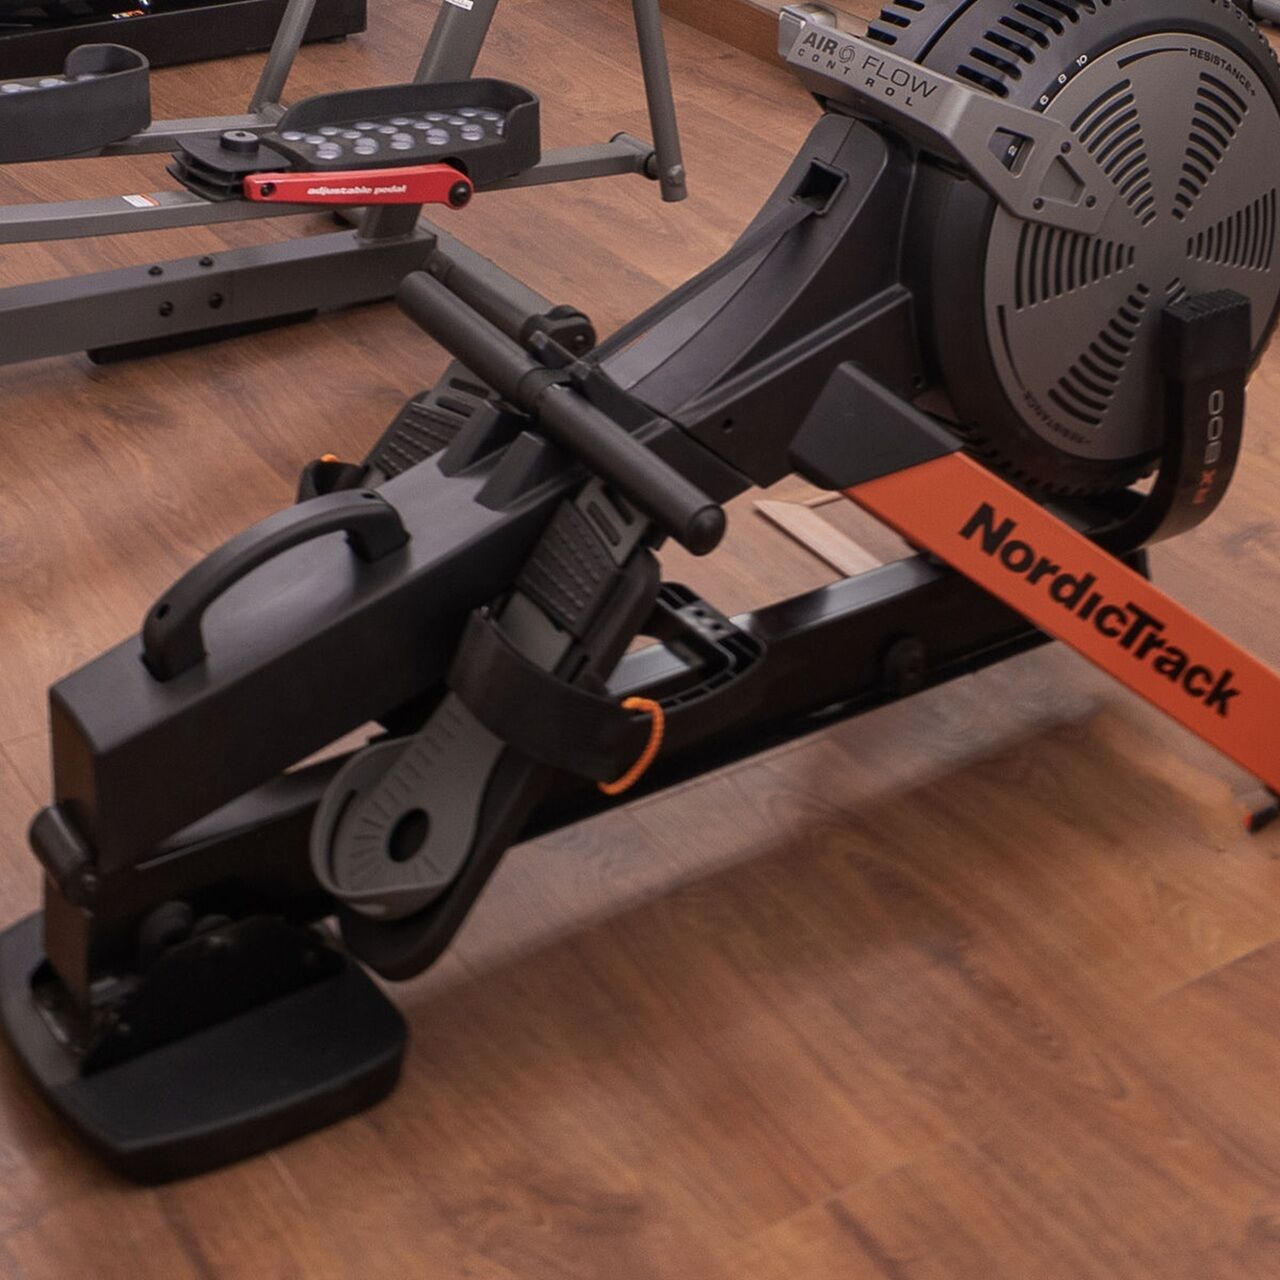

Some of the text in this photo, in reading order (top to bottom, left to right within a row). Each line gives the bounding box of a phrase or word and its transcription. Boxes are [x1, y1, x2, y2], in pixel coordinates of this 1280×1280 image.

[803, 31, 939, 99] AIR FLOW
[1076, 54, 1088, 66] 10
[306, 184, 408, 196] adjustable pedal
[958, 501, 1241, 717] NordicTrack
